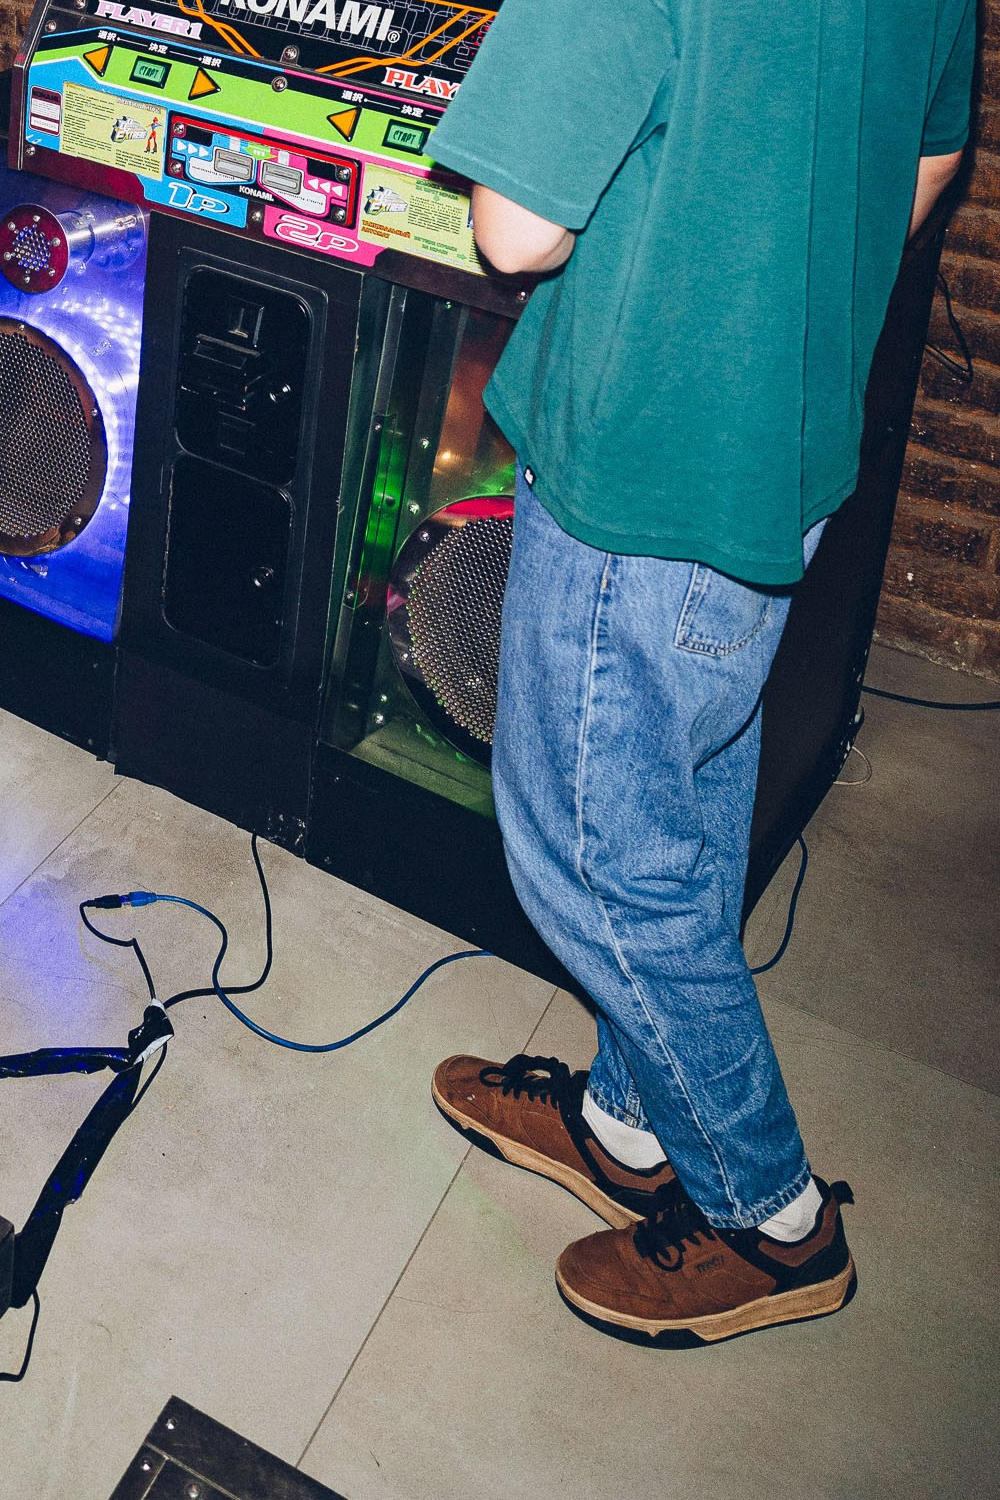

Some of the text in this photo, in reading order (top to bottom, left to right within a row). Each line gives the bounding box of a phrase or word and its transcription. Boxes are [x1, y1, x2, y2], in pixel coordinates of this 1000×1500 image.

[97, 30, 222, 68] 選択 決定 選択
[341, 89, 425, 118] 選択 決定
[167, 181, 230, 214] 1P
[238, 185, 274, 202] KONAMI
[275, 214, 359, 252] 2P
